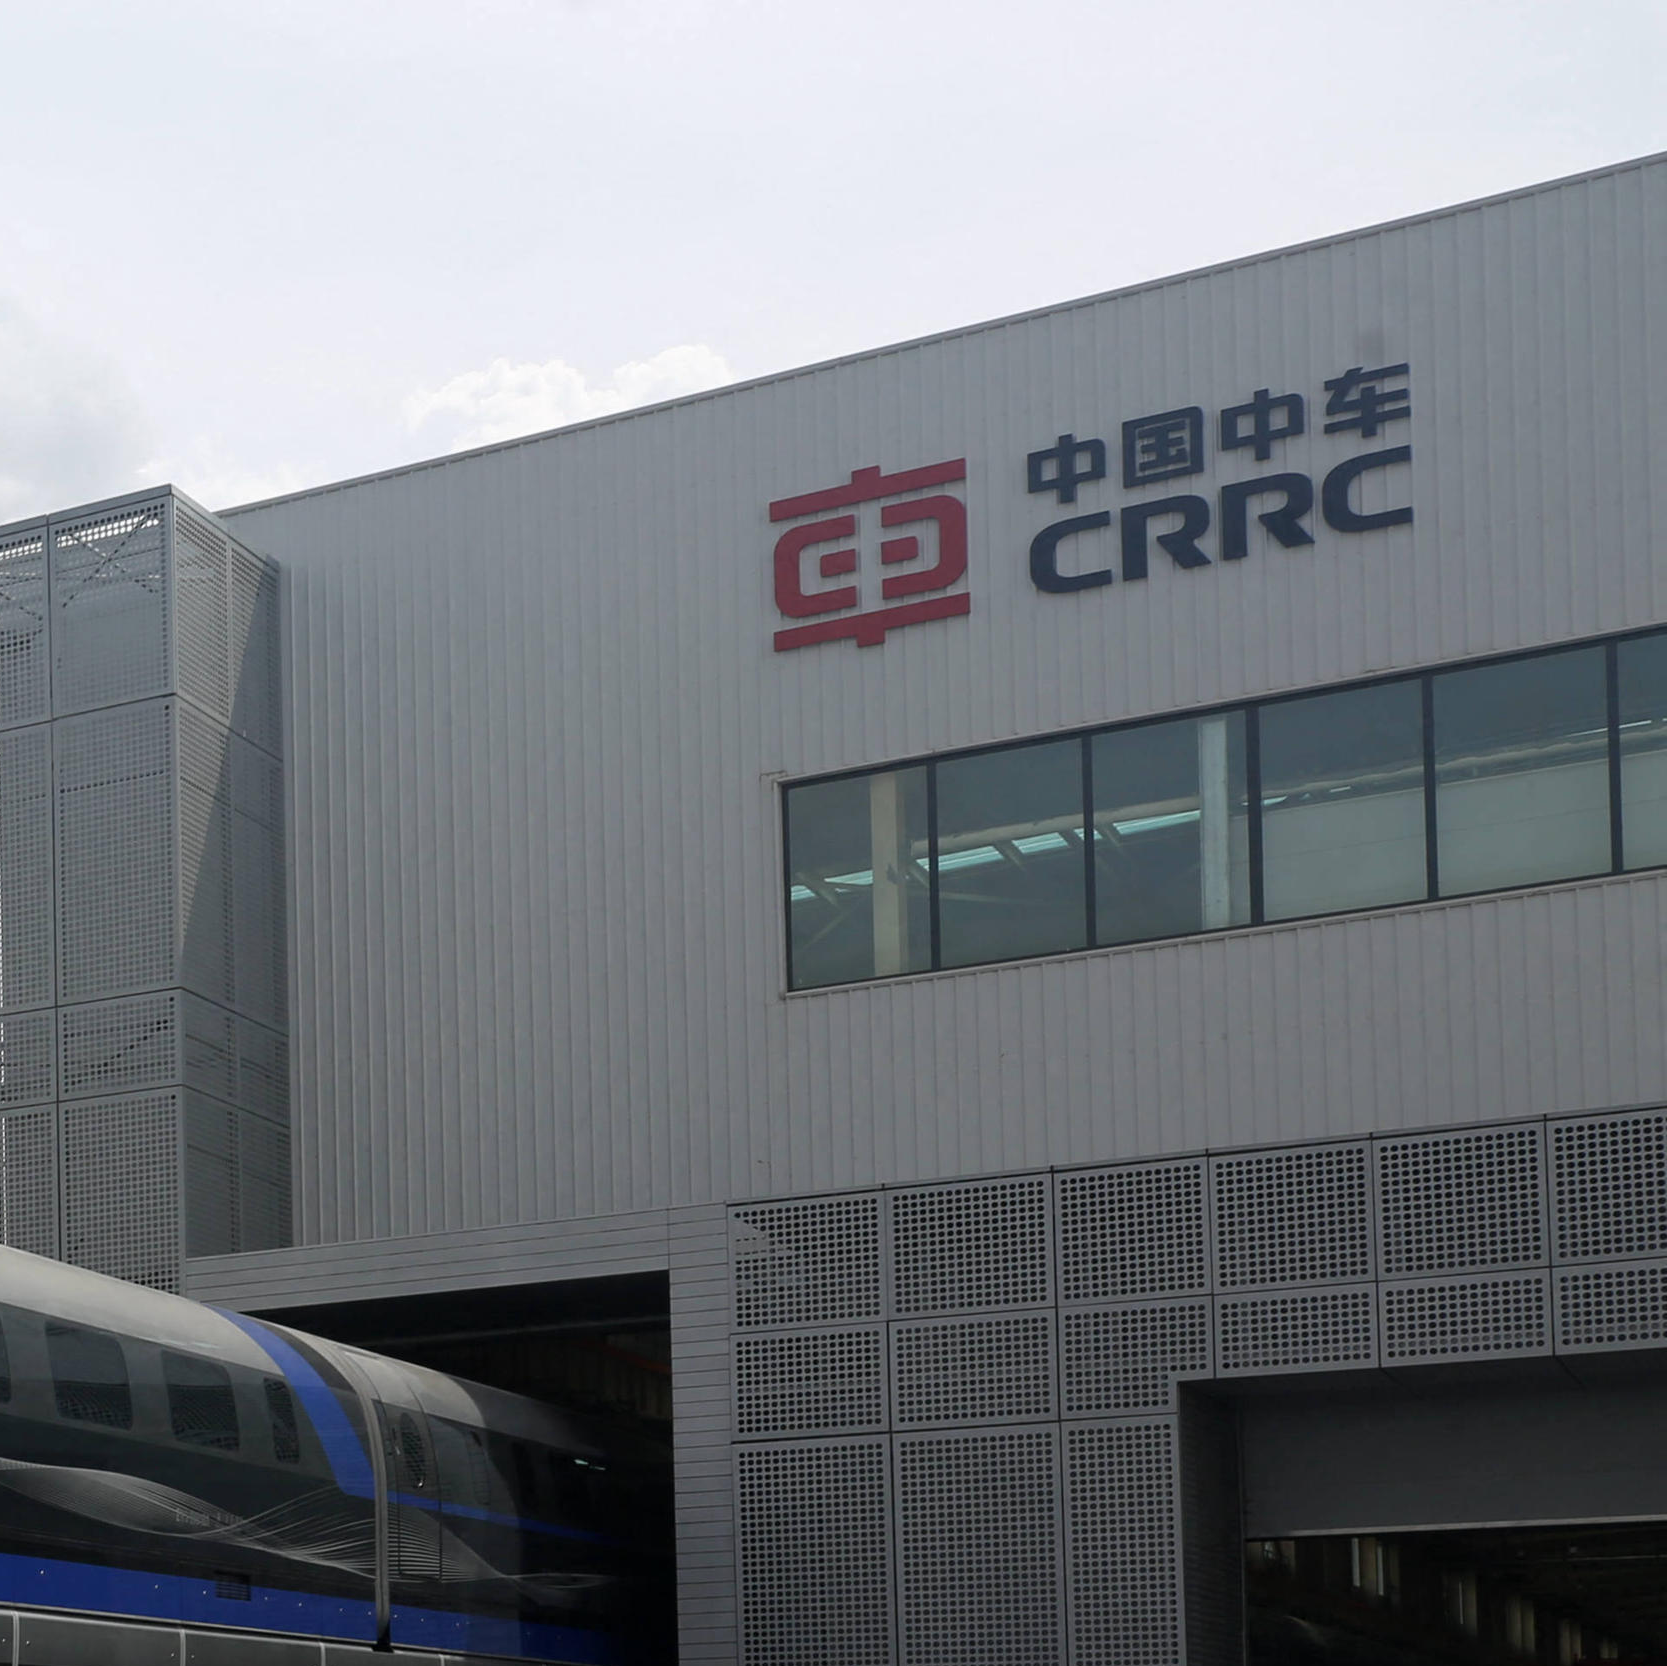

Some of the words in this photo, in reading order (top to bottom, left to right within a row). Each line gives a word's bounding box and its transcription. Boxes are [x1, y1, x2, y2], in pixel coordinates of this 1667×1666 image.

[1027, 363, 1411, 504] 中国中车
[1030, 444, 1413, 594] CRRC
